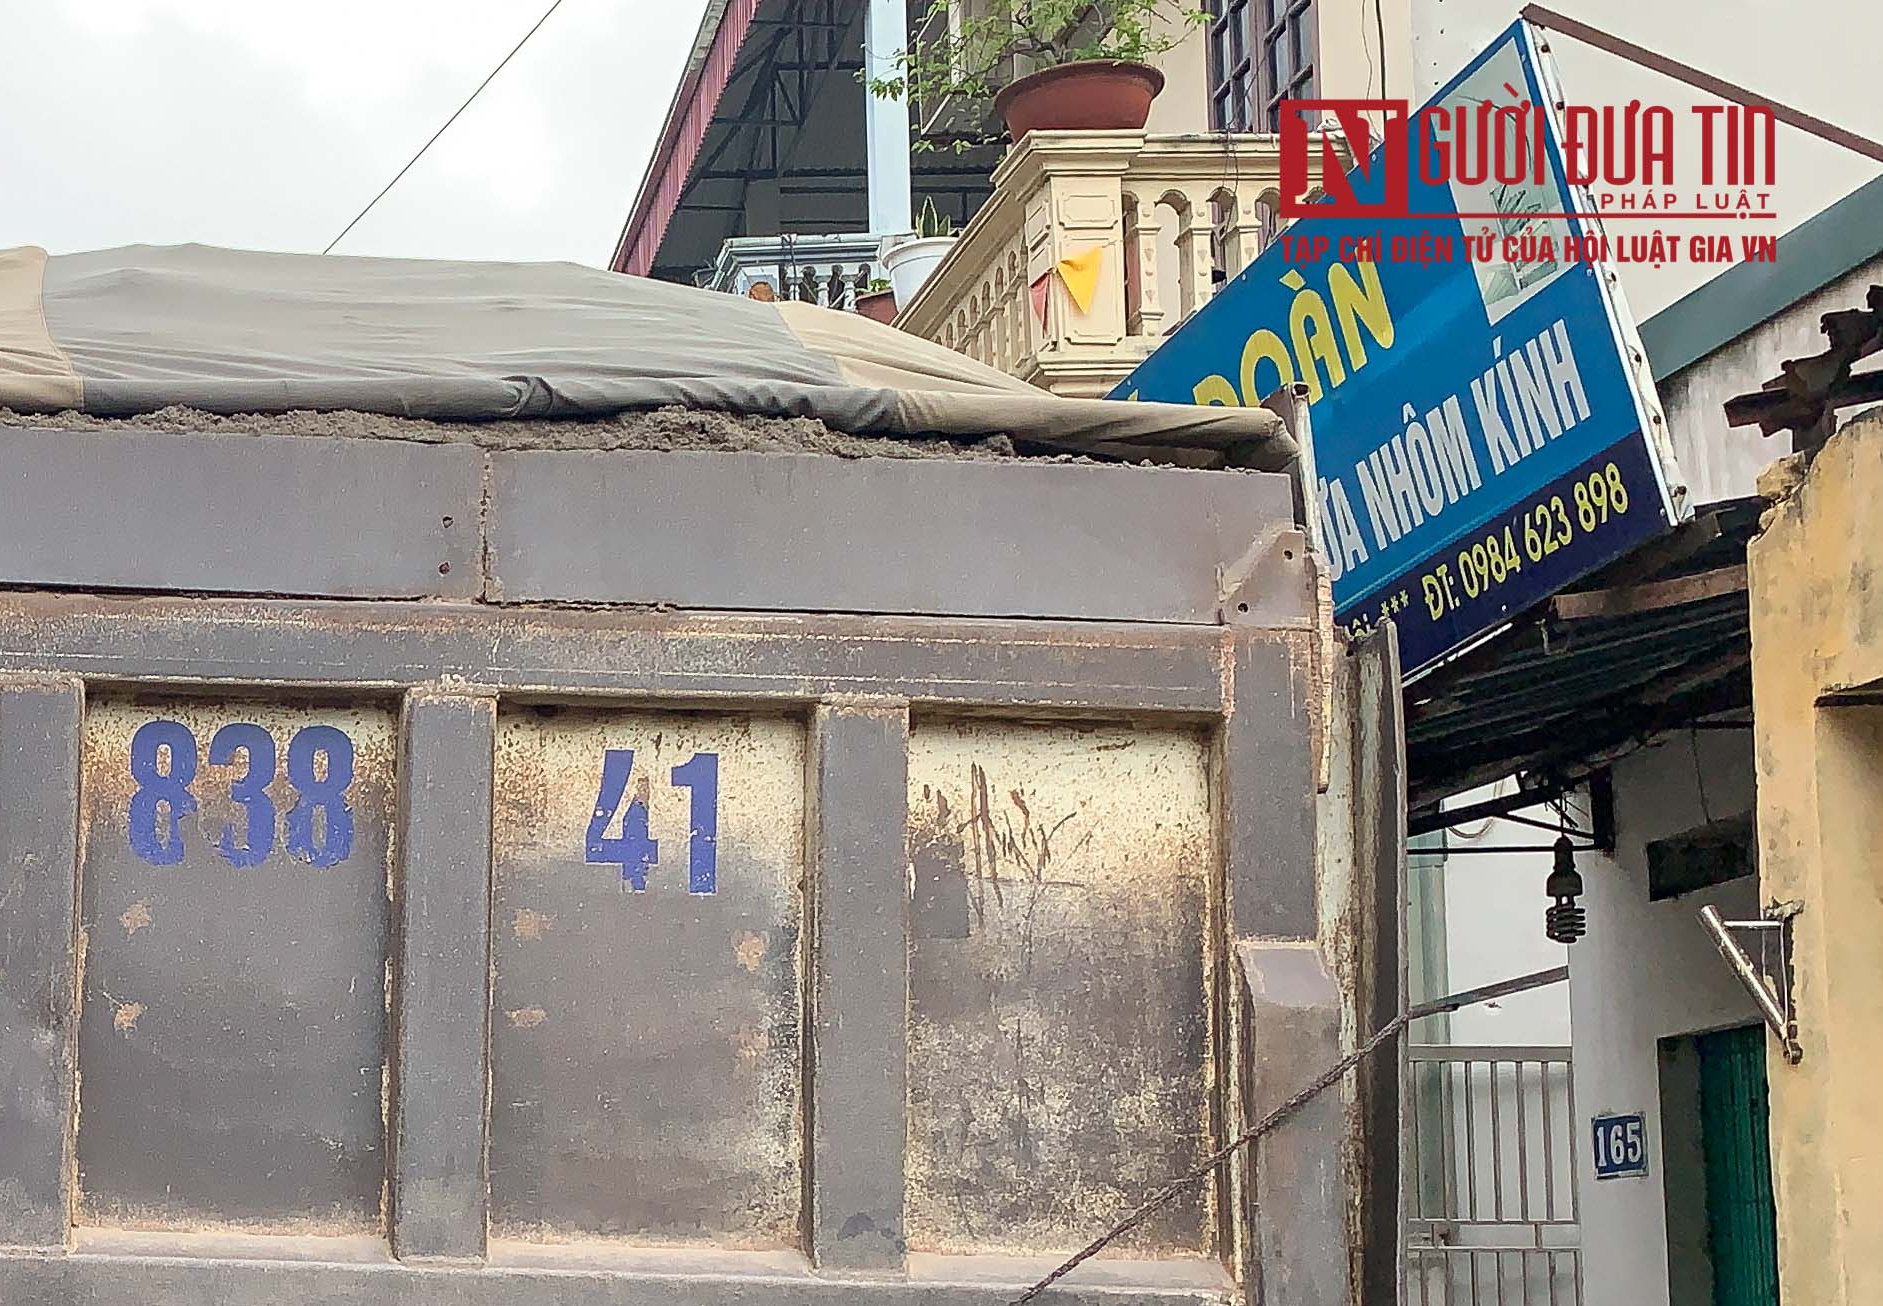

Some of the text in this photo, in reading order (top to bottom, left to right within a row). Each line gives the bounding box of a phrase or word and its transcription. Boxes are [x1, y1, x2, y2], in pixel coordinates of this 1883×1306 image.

[1355, 394, 1483, 551] NHÔM
[1470, 319, 1591, 476] KÍNH
[1457, 525, 1521, 601] 0984
[1524, 495, 1573, 562] 623
[1573, 462, 1629, 533] 898
[128, 719, 356, 870] 838
[585, 748, 720, 895] 41
[1597, 1121, 1642, 1167] 165
